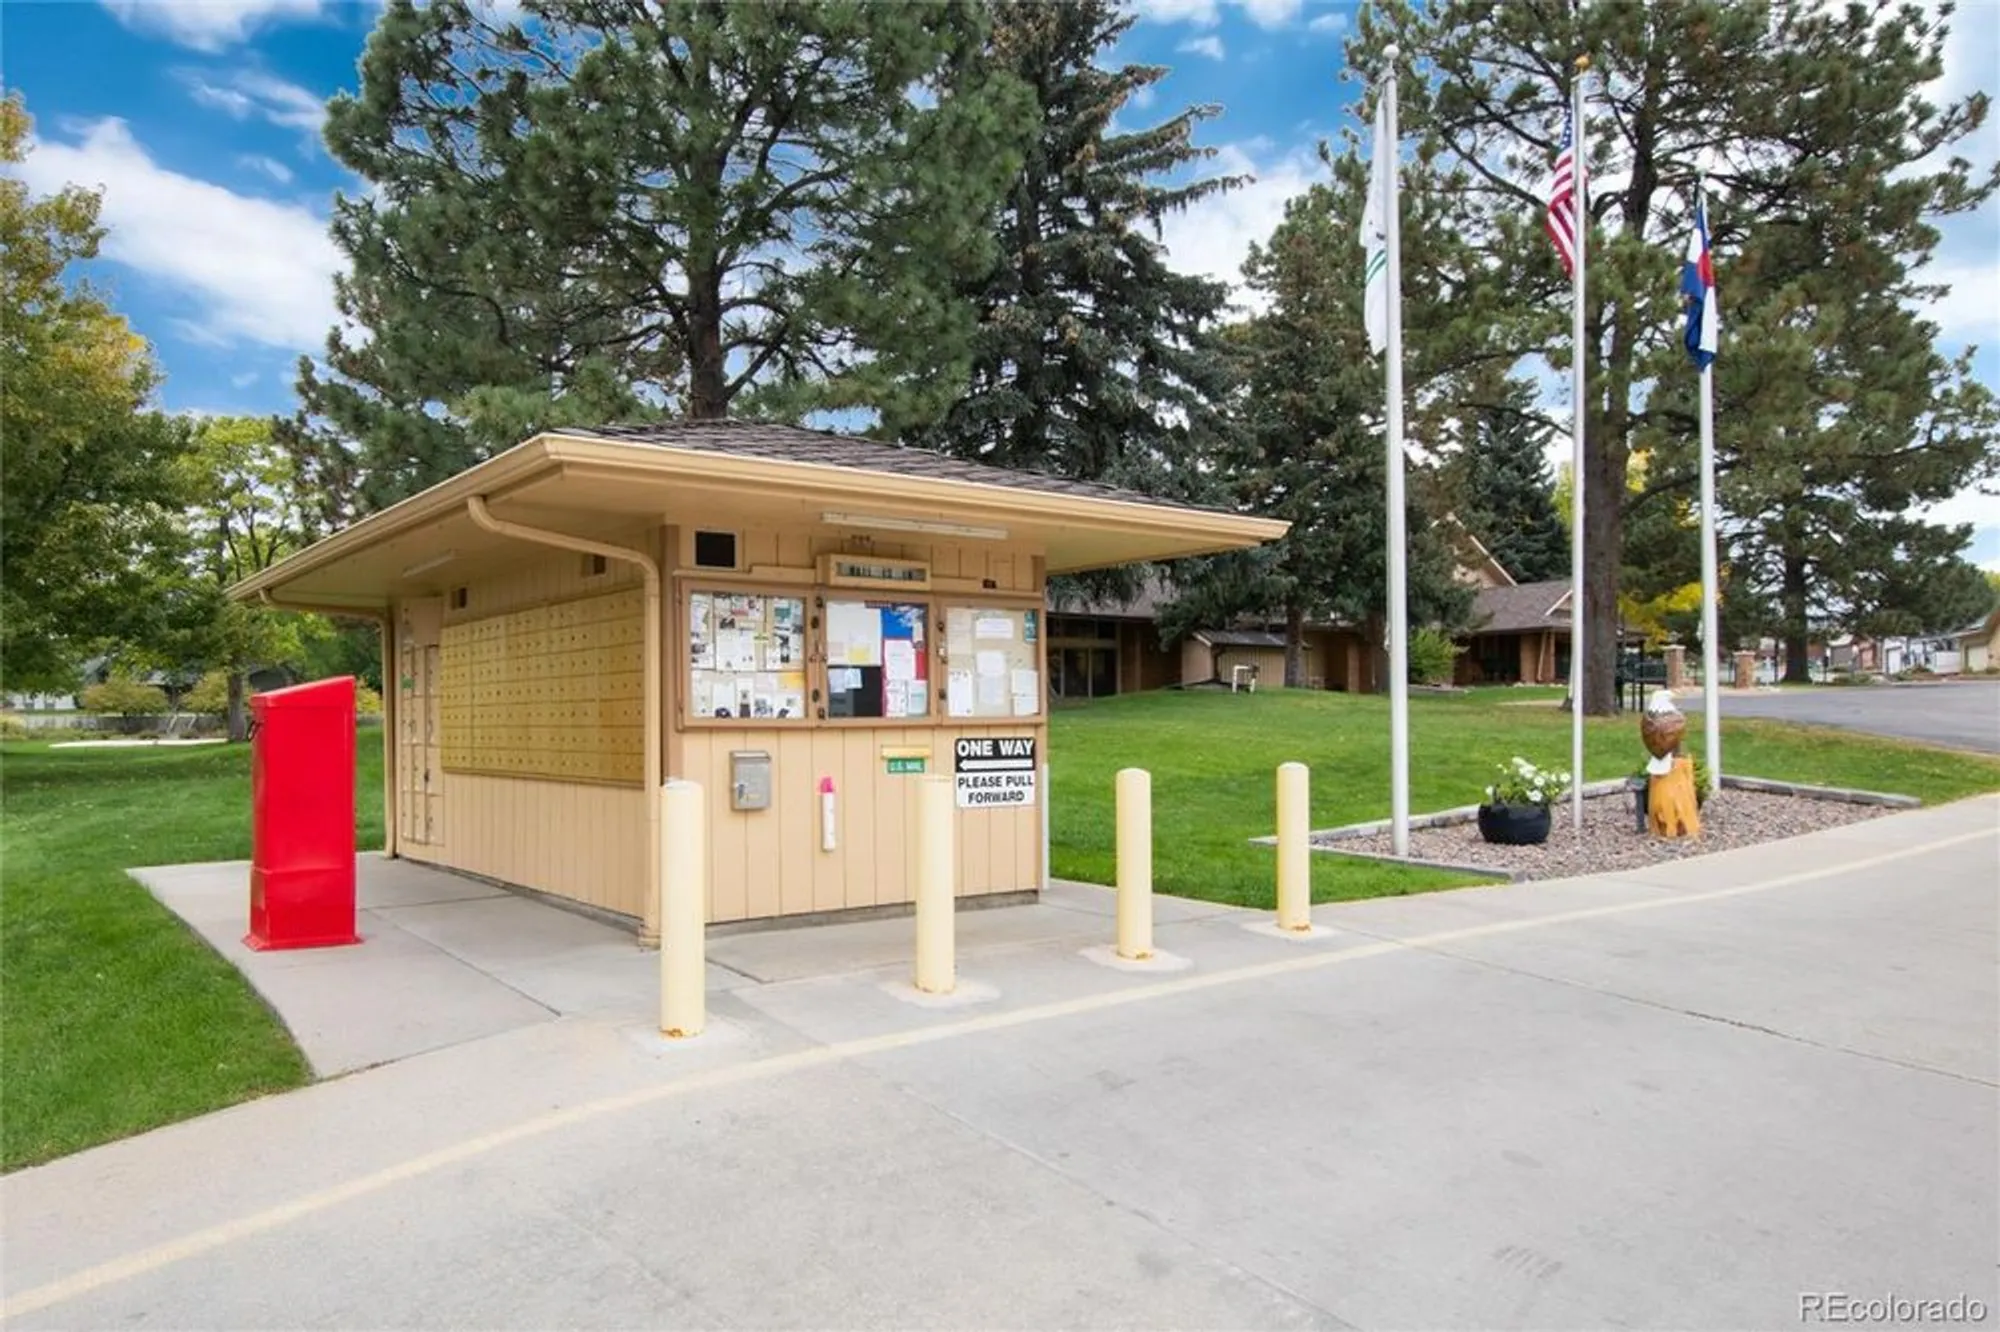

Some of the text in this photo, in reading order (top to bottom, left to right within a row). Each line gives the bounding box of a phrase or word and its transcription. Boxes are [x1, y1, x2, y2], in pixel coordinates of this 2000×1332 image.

[957, 739, 1034, 756] ONE WAY
[958, 775, 1034, 789] PLEASE PULL
[968, 790, 1025, 804] FORWARD
